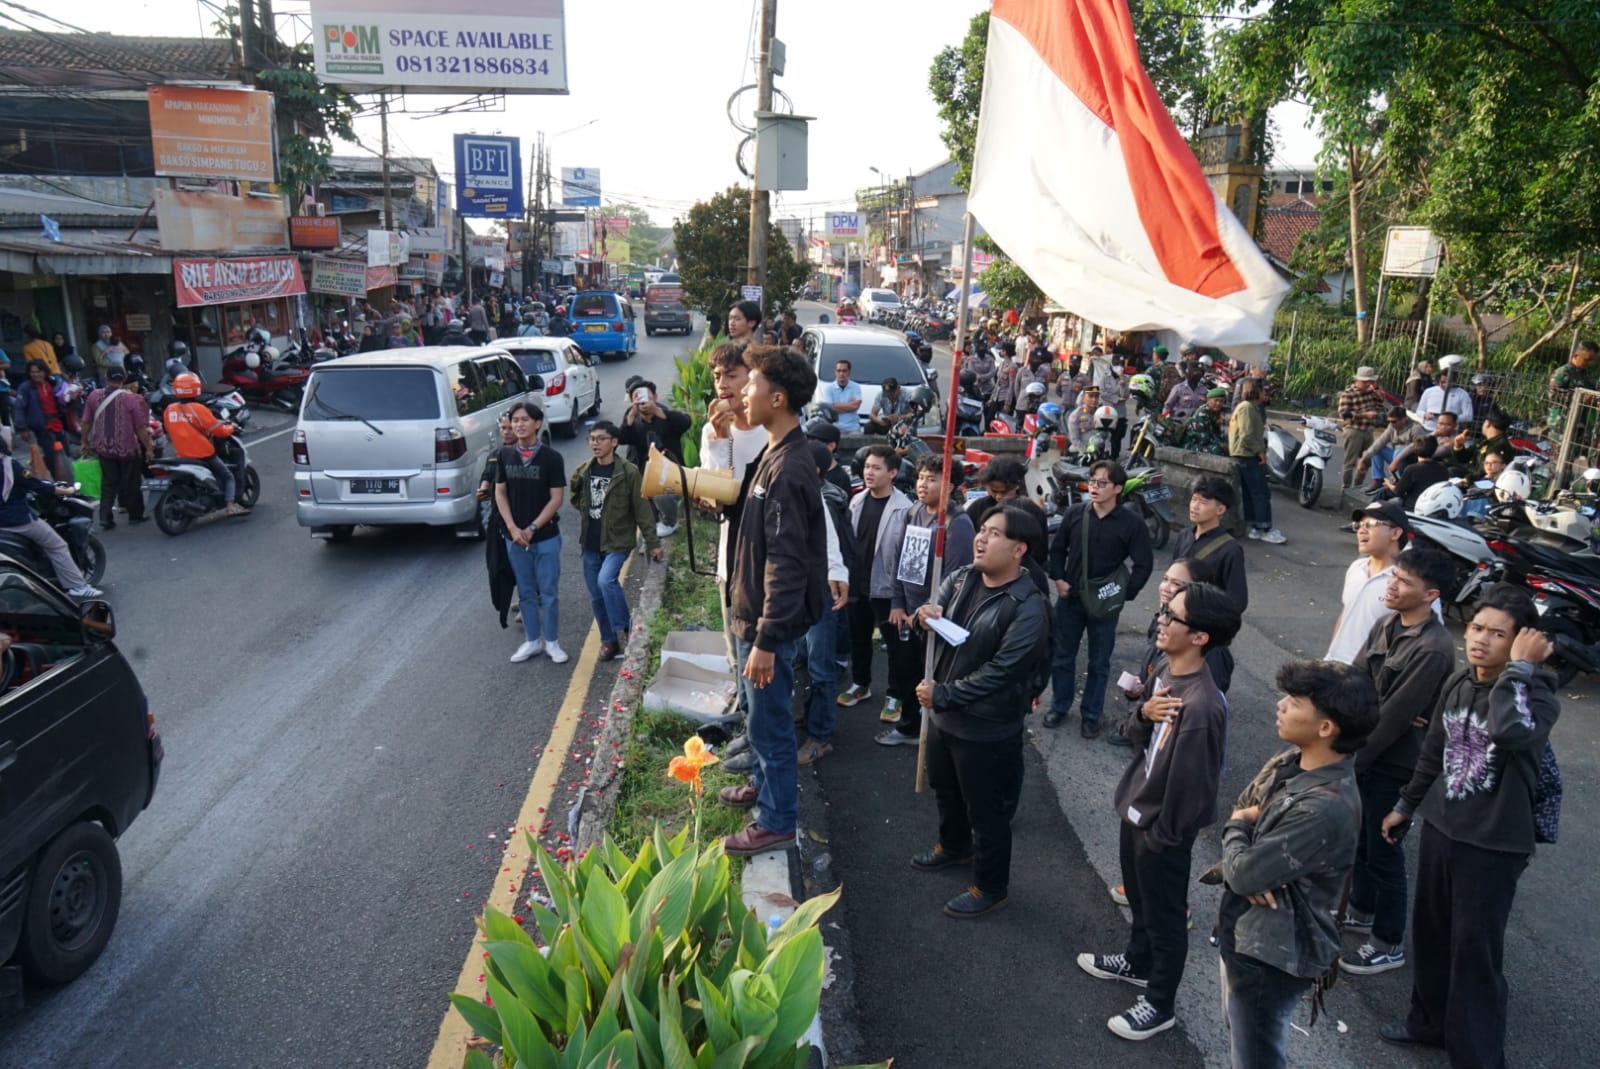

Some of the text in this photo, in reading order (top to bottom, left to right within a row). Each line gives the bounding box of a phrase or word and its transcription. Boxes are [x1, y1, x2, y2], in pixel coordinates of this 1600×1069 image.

[388, 28, 554, 50] SPACE AVAILABLE
[396, 55, 550, 76] 081321886834
[160, 154, 190, 167] BAKSO
[192, 157, 233, 169] SIMPANG
[235, 159, 260, 172] TUGU
[471, 148, 507, 172] BFI
[832, 215, 858, 228] DPM
[181, 262, 211, 289] MIE
[214, 261, 247, 287] AYAM
[249, 262, 258, 284] &
[260, 259, 295, 283] BAKSO
[904, 535, 930, 557] 1312
